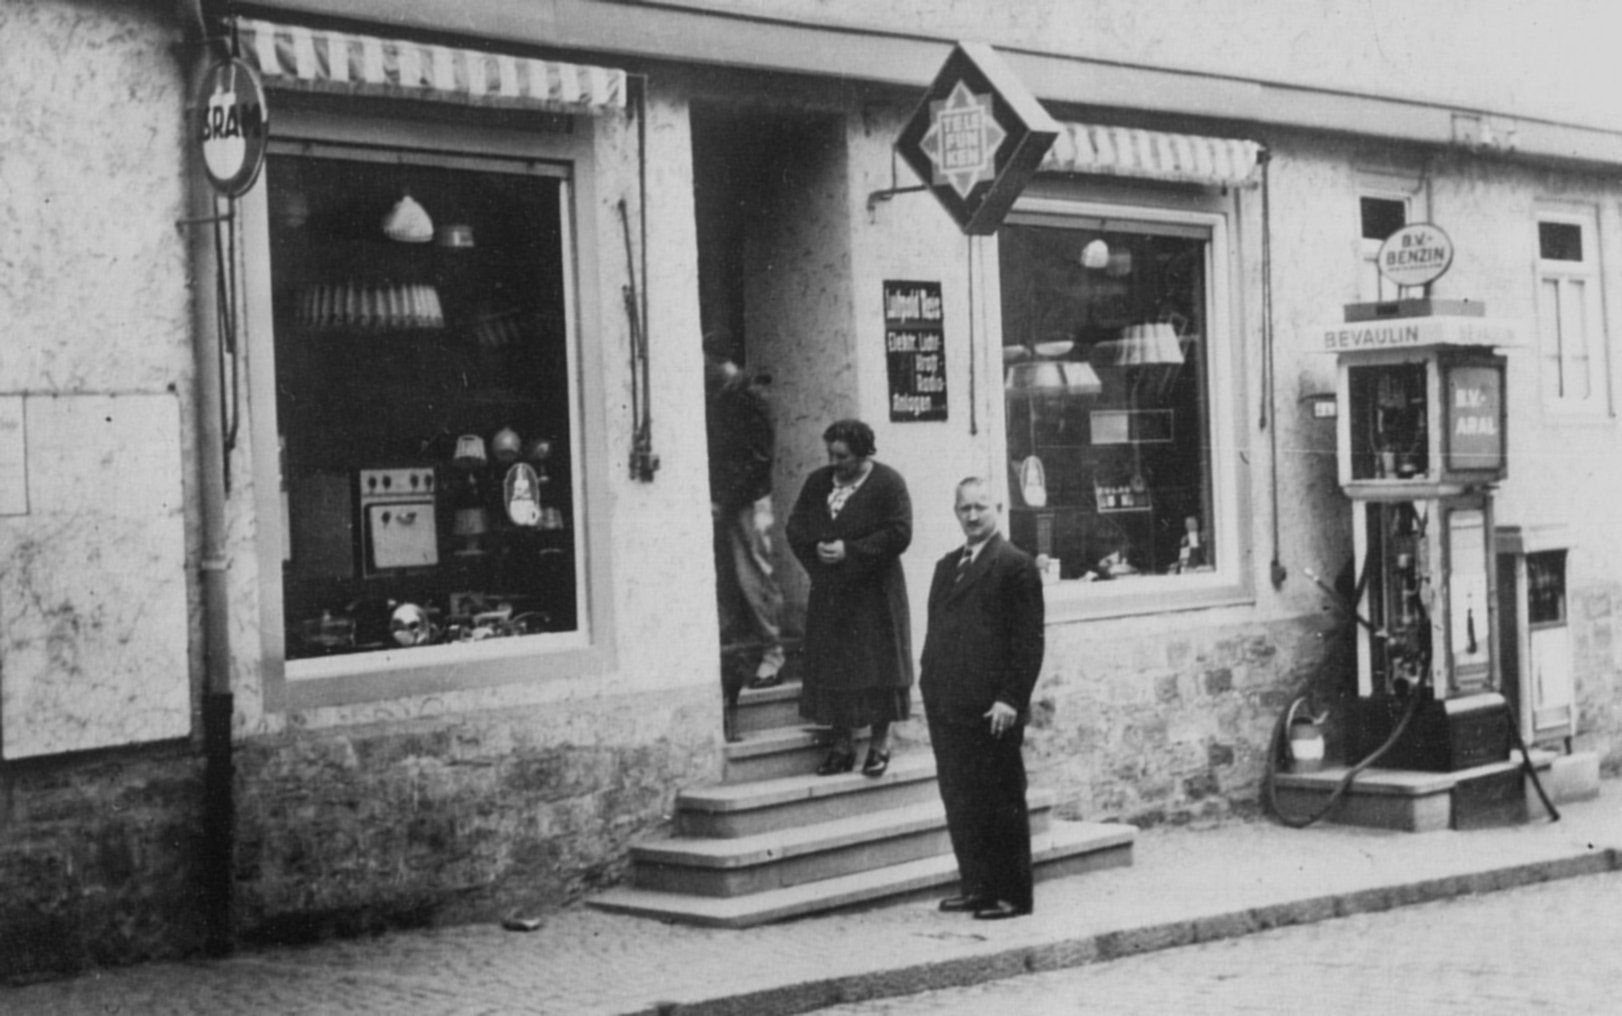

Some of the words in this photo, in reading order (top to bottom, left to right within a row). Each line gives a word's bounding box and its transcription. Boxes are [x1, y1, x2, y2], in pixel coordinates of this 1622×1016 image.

[198, 102, 262, 140] SRAM
[1386, 247, 1444, 266] BENZIN
[1323, 326, 1419, 349] BEVAULIN
[1455, 416, 1497, 435] ARAL
